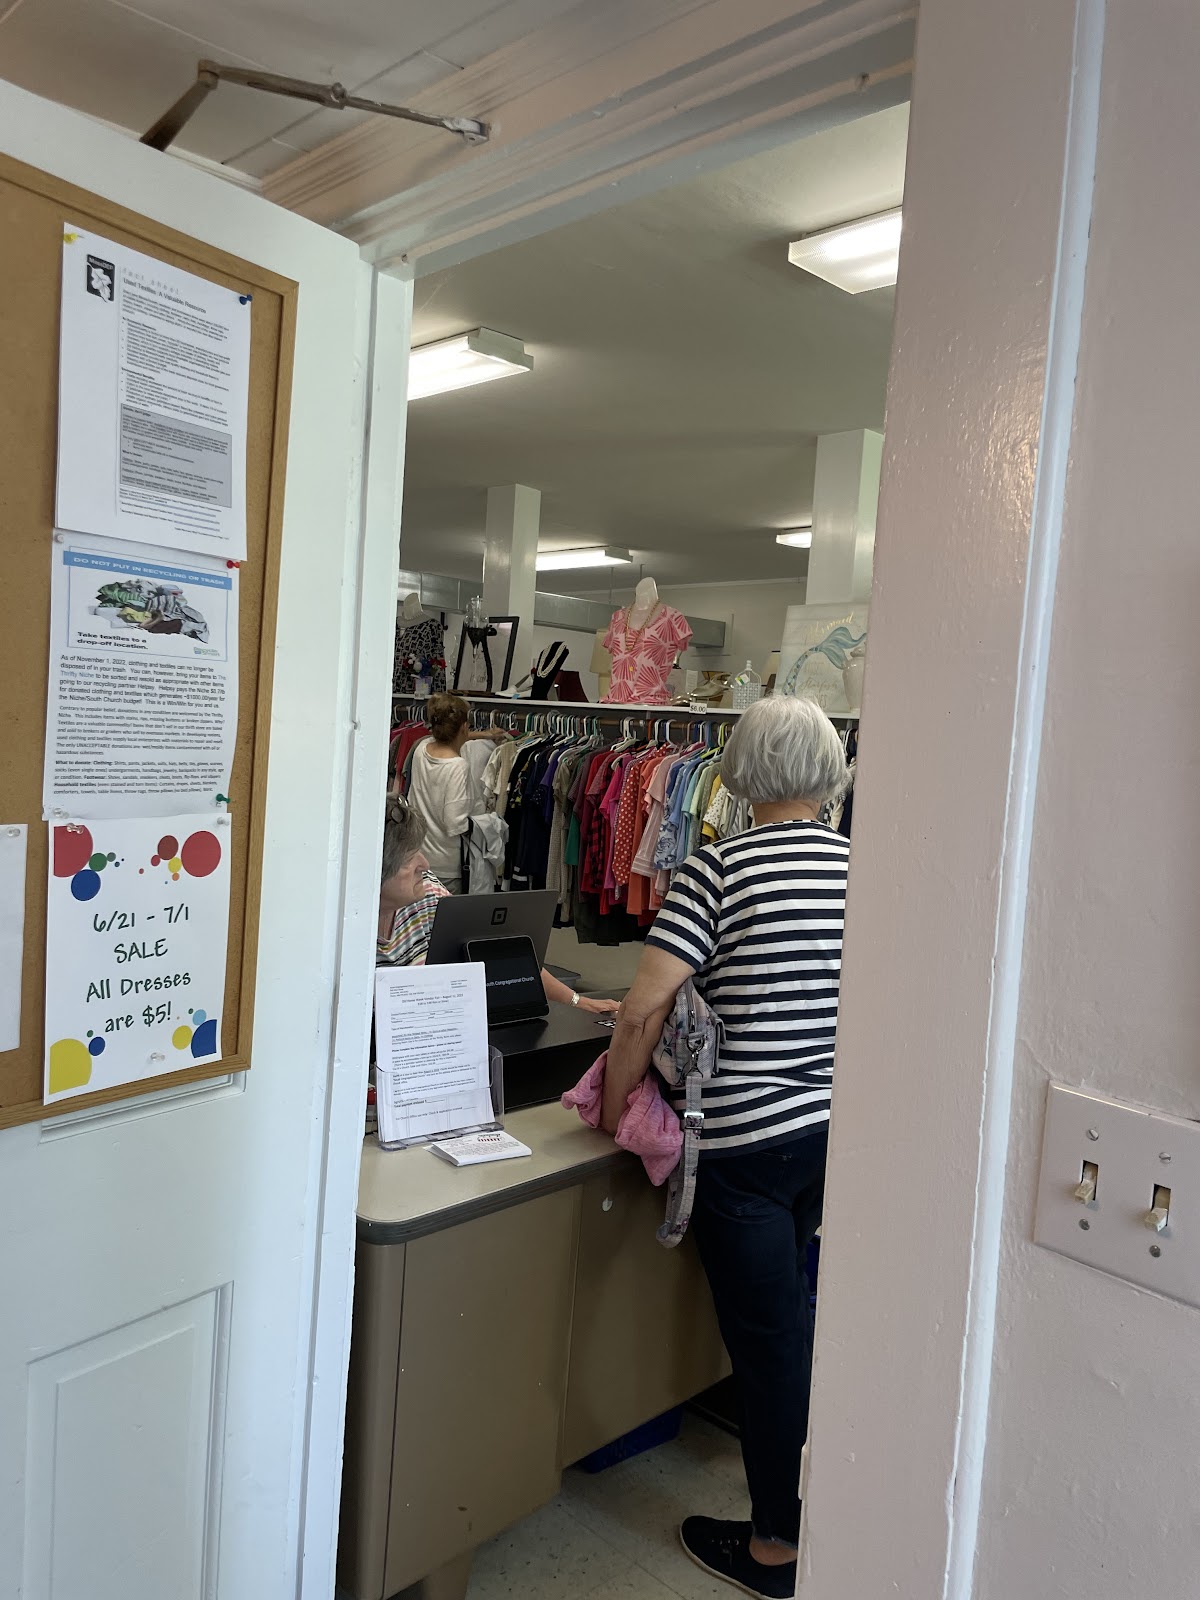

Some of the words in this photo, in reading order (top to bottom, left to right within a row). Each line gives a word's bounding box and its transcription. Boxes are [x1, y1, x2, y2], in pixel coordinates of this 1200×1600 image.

[112, 562, 130, 570] PUT
[143, 567, 186, 579] RECYCLING
[201, 577, 224, 585] TRASH
[77, 639, 112, 648] drop-off
[93, 911, 135, 933] 6/21
[164, 903, 189, 925] 7/1
[114, 938, 168, 964] SALE
[86, 978, 111, 1002] All
[120, 971, 191, 996] Dresses
[495, 978, 521, 986] Congregational
[105, 1013, 134, 1033] are
[142, 1001, 172, 1027] $5!
